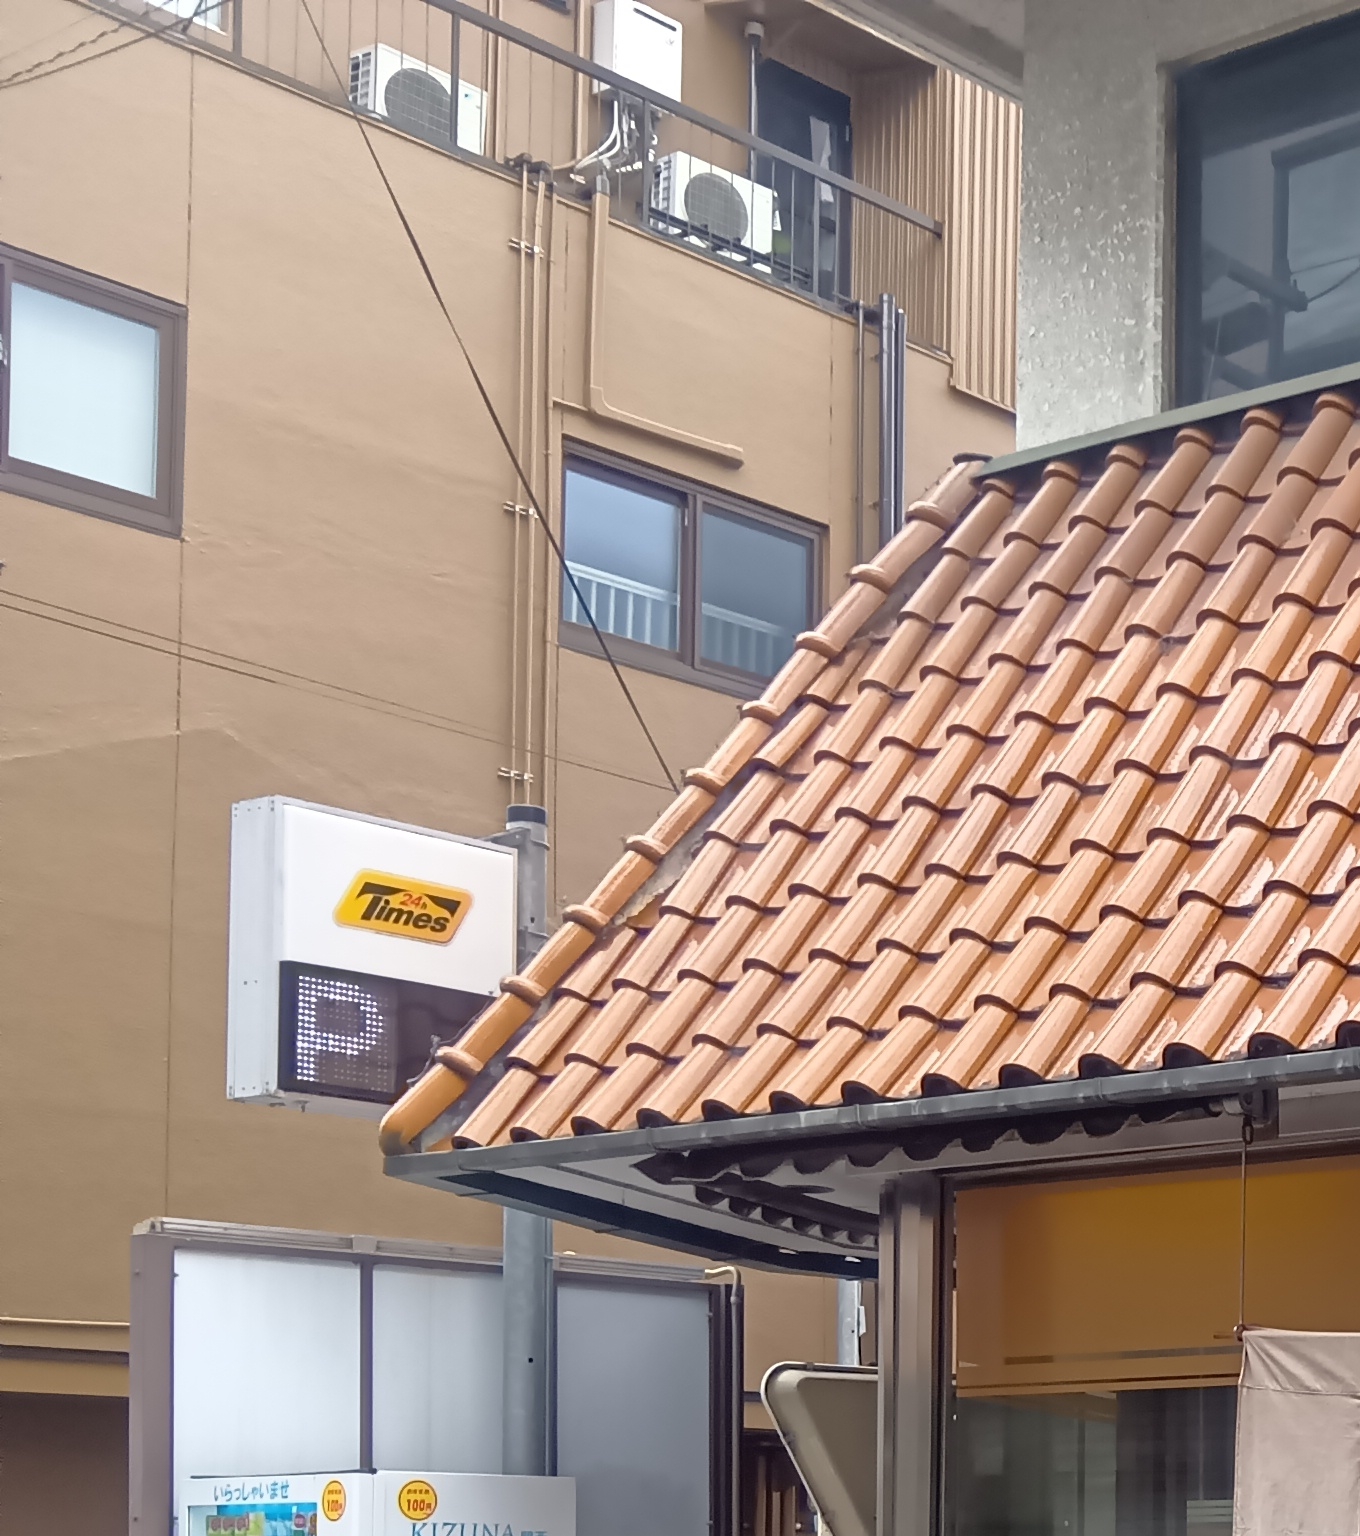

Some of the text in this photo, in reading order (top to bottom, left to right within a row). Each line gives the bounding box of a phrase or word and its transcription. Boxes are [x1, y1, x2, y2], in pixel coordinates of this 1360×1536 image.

[356, 882, 461, 933] Times
[297, 975, 383, 1081] P
[213, 1479, 290, 1502] いらっしゃいませ
